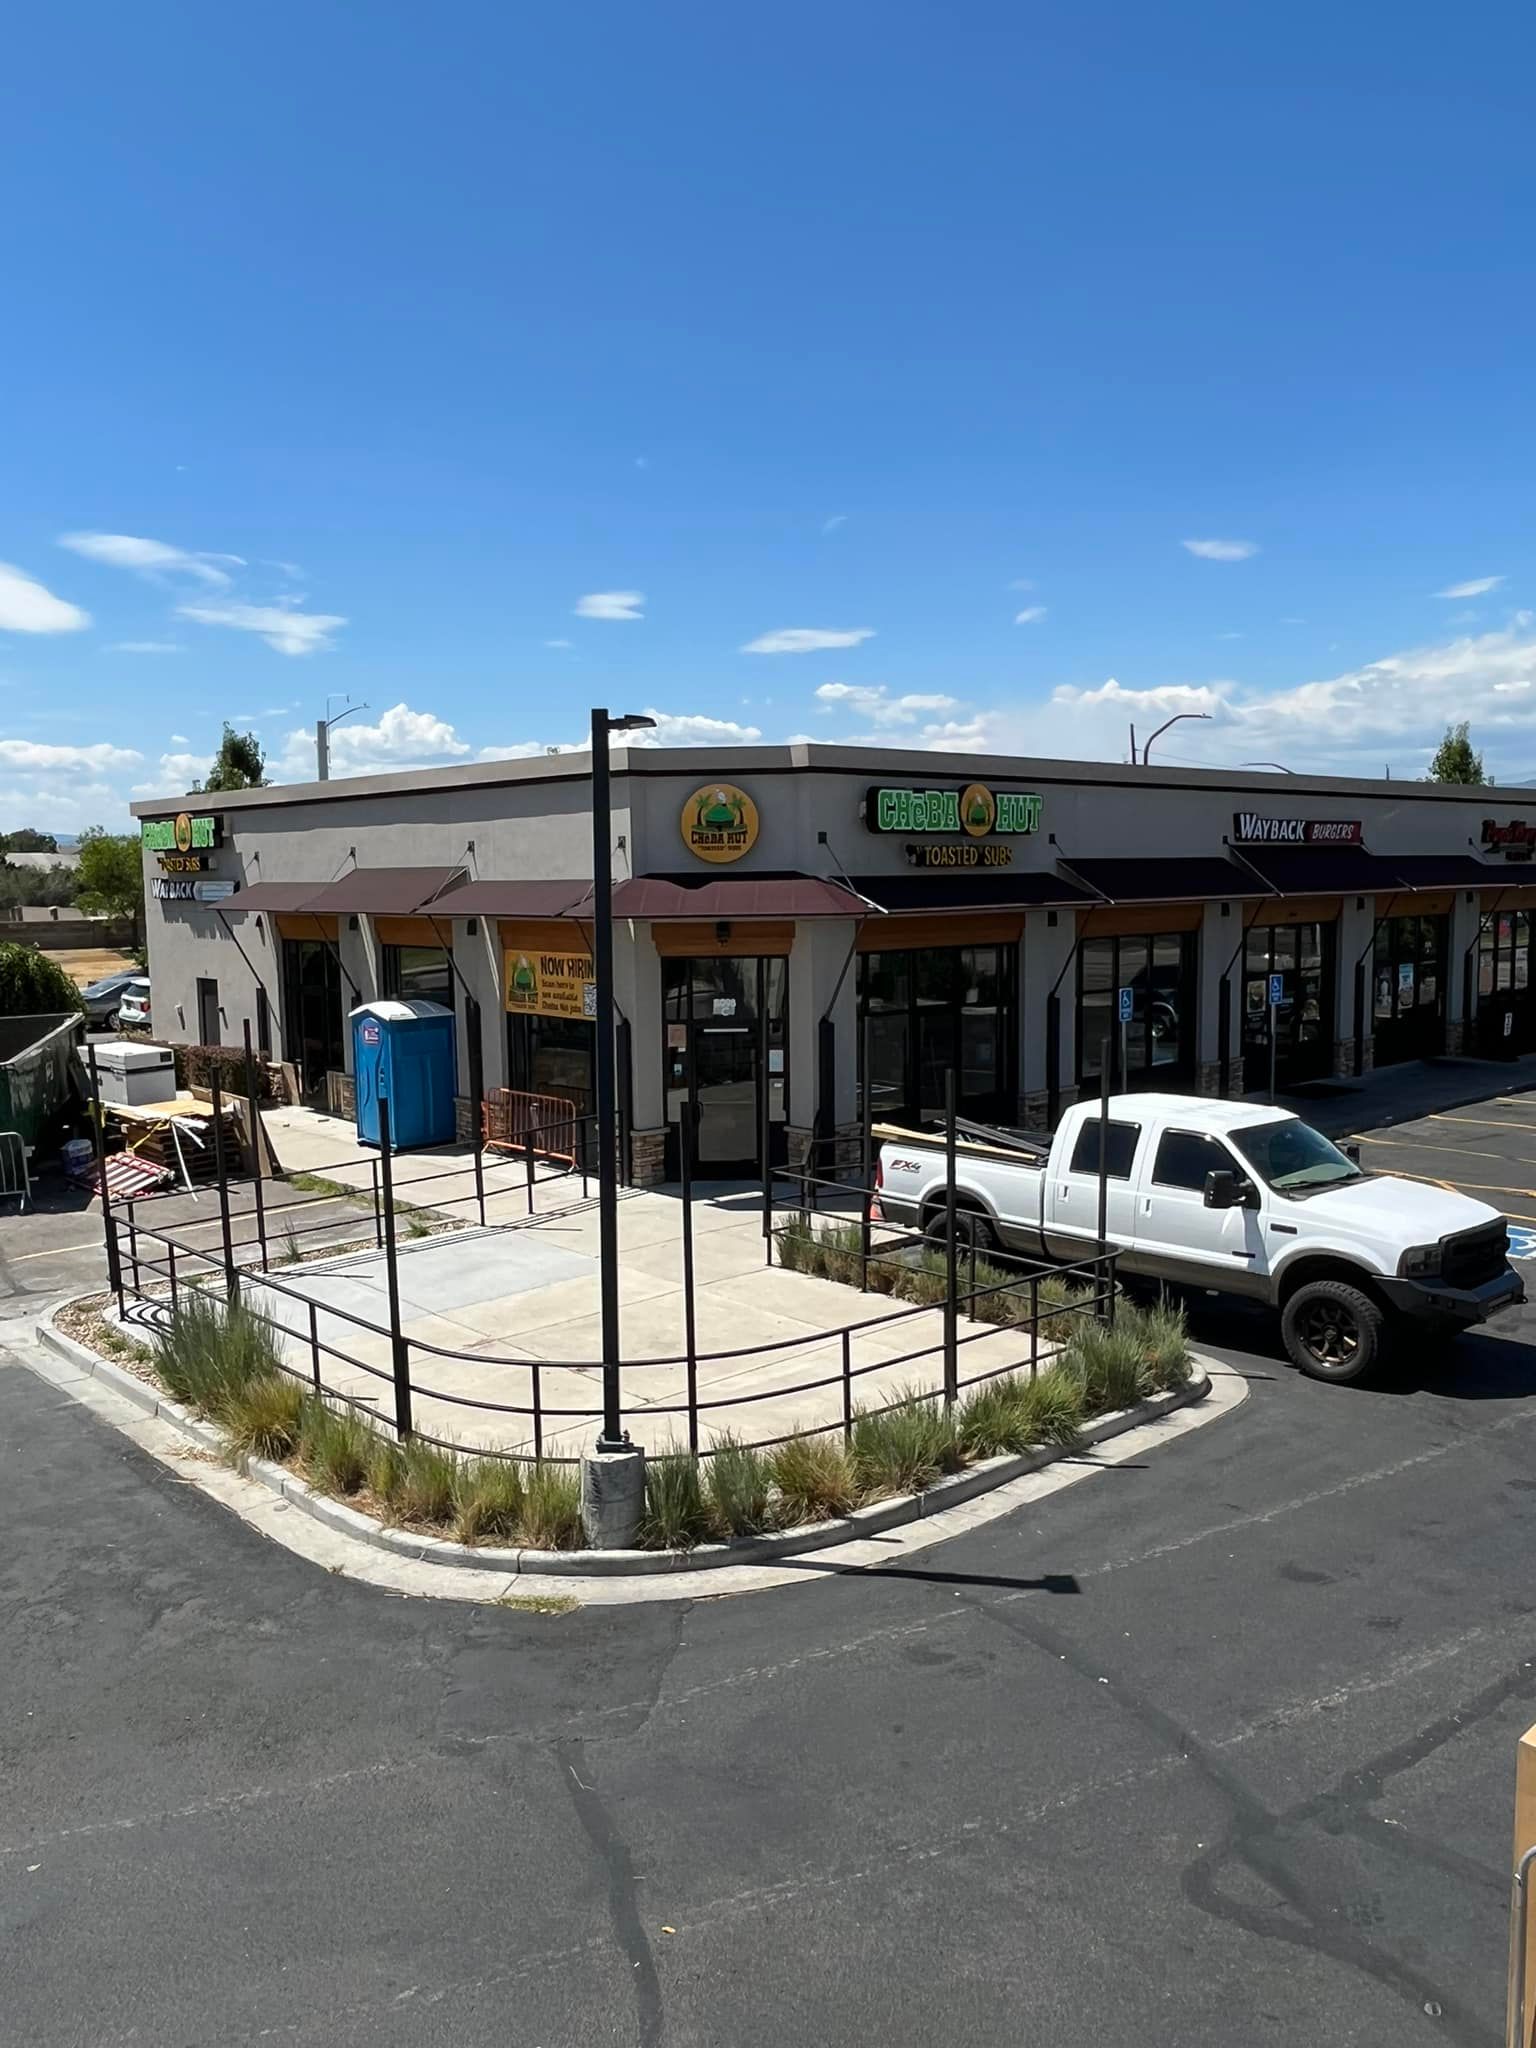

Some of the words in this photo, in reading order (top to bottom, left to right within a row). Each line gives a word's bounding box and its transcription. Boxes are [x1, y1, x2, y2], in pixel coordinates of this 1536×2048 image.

[996, 794, 1042, 832] HUT
[191, 817, 215, 848] HUT
[727, 830, 748, 844] HUT
[1312, 823, 1354, 839] BURGERS
[984, 846, 1013, 866] SUBS
[541, 956, 564, 976] NOW
[567, 958, 594, 979] HIRIN
